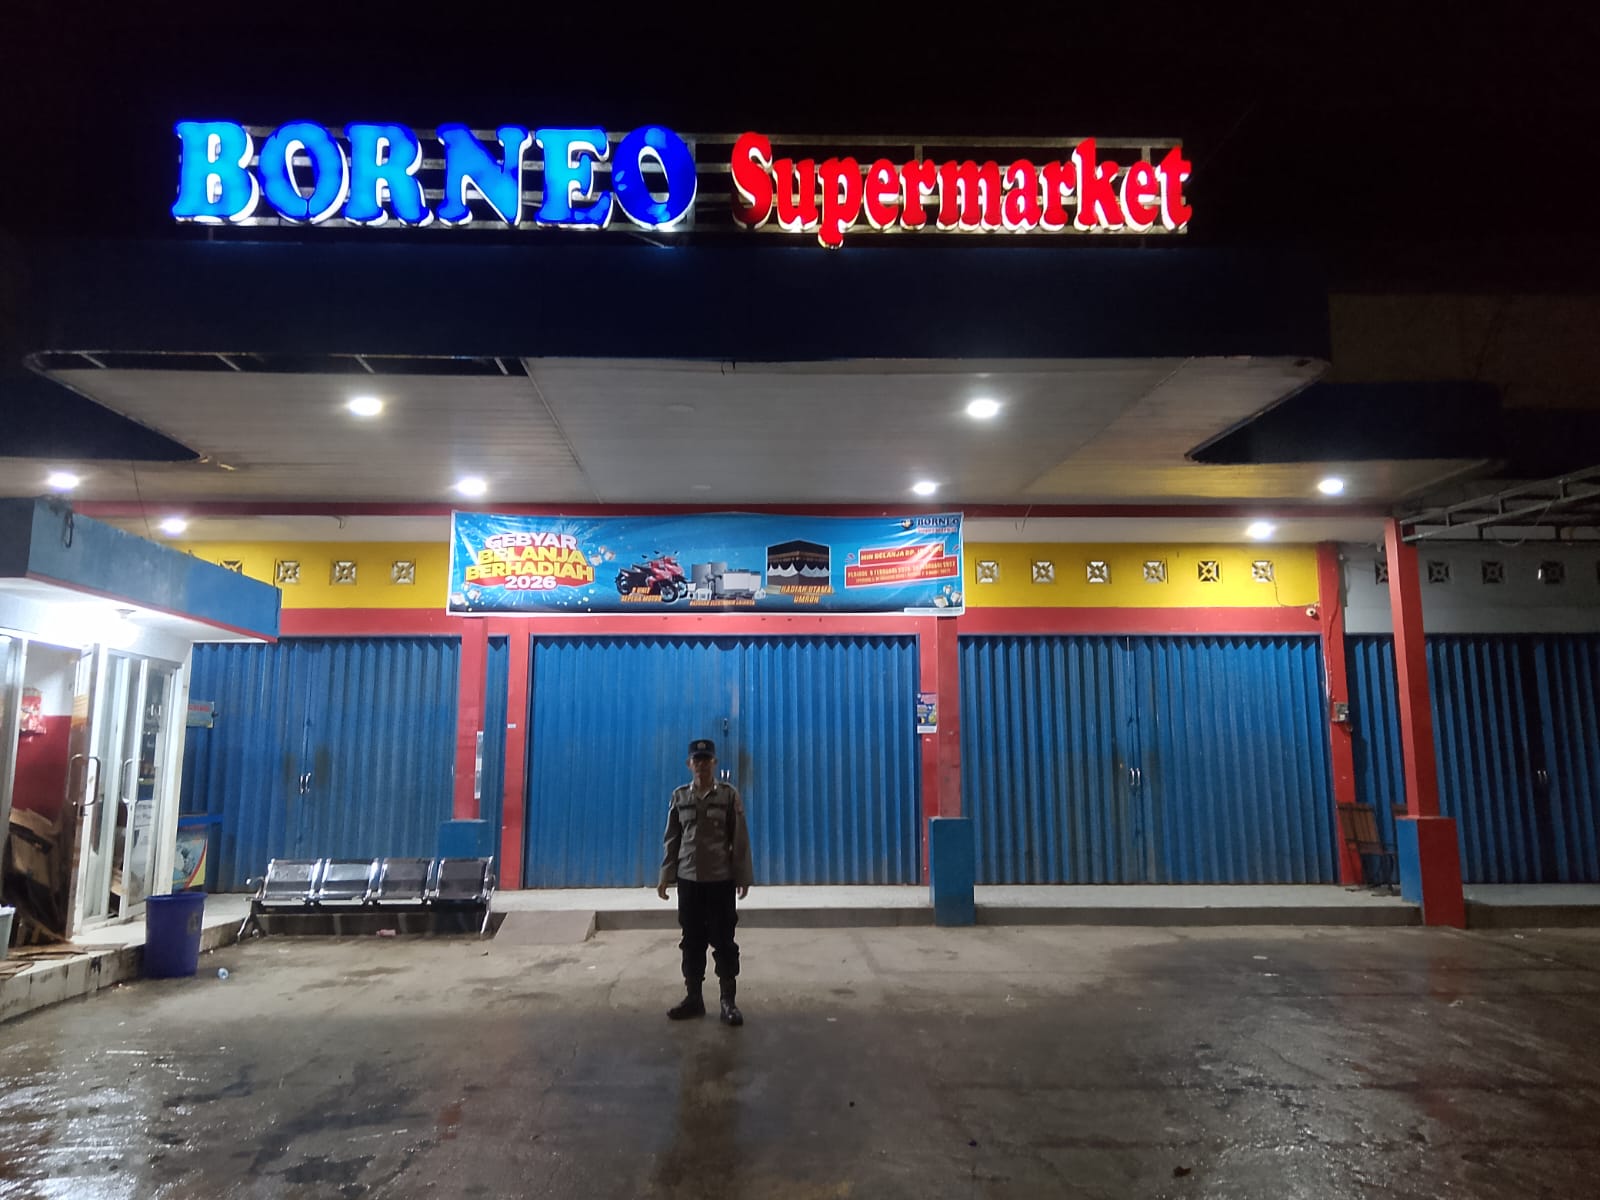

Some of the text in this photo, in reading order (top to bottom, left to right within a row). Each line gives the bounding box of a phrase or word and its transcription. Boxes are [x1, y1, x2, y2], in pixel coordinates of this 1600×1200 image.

[171, 119, 1194, 251] BORNEO Supermarket
[484, 532, 577, 551] GEBYAR
[477, 546, 587, 565] BELANJA
[874, 550, 905, 560] BELANJA
[465, 561, 594, 582] BERHADIAH
[504, 575, 558, 590] 2026
[780, 585, 833, 593] HADIAH UTAMA
